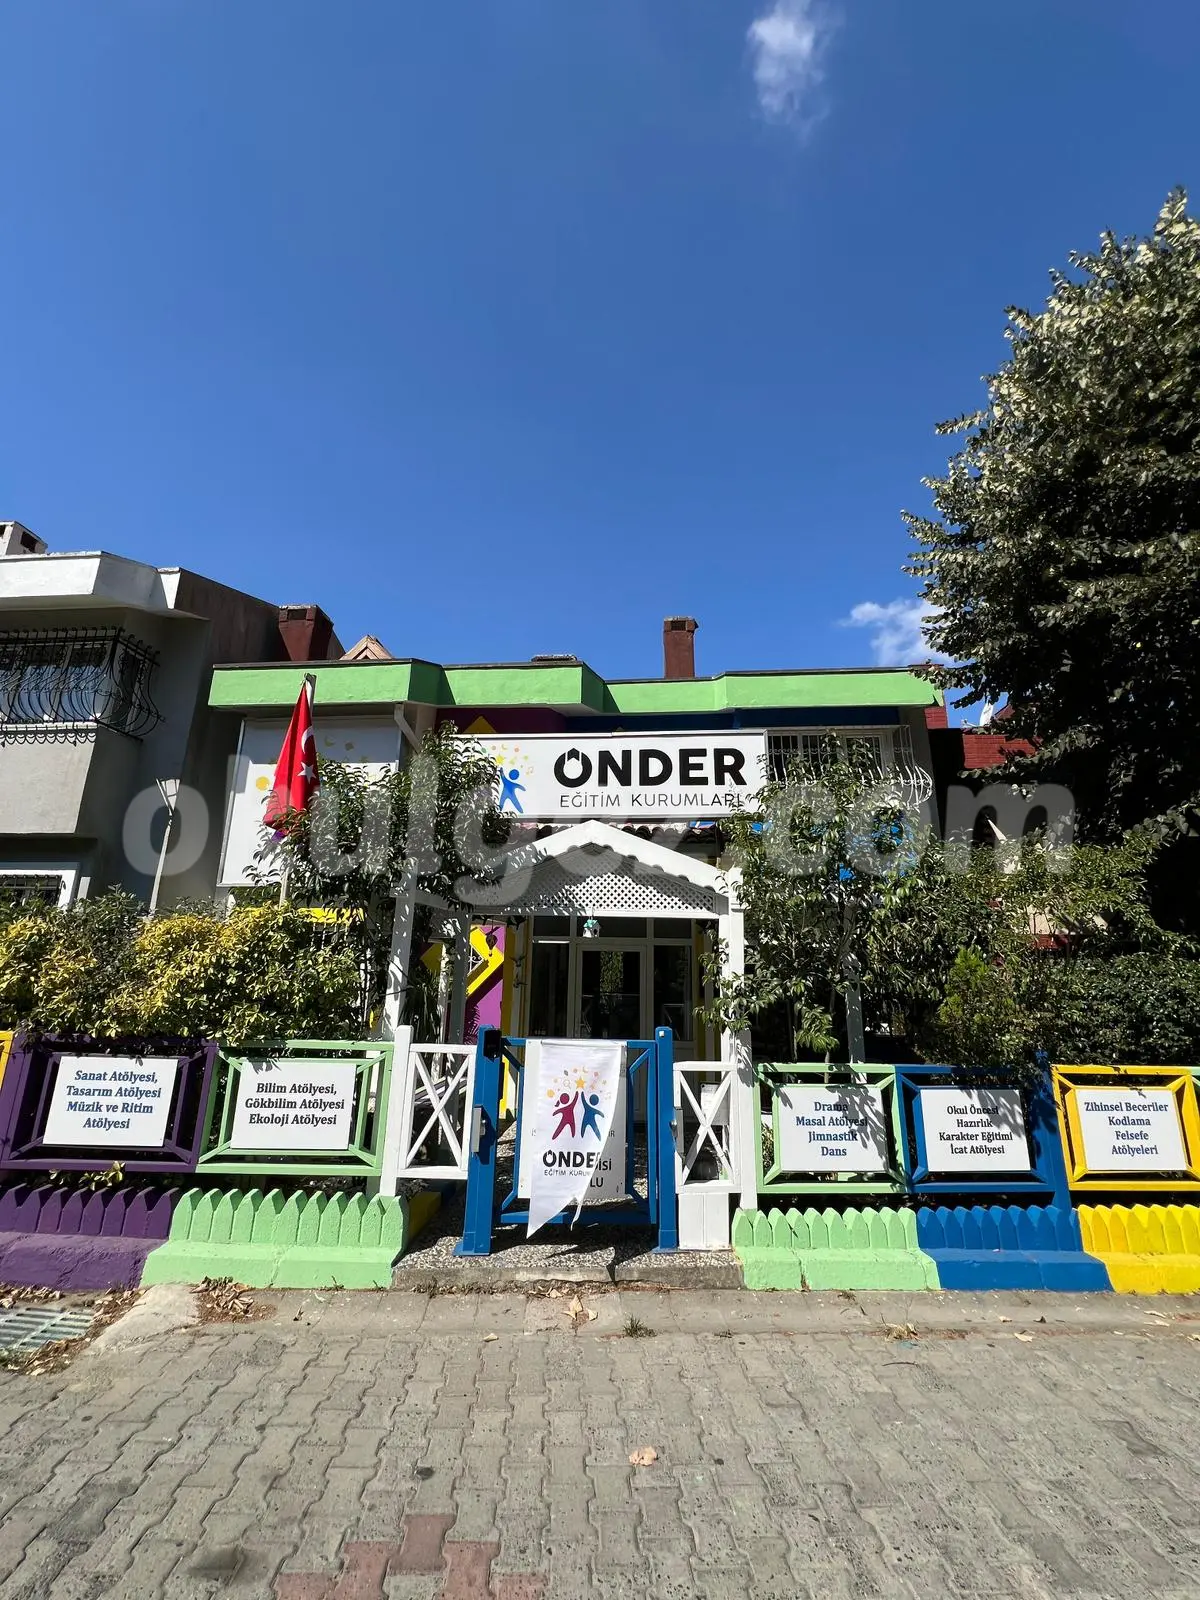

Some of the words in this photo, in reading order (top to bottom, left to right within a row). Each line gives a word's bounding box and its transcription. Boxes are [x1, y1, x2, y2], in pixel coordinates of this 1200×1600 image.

[560, 791, 620, 808] EĞİTİM
[631, 793, 740, 807] KURUMLARI
[75, 1070, 107, 1081] Sanat
[109, 1071, 158, 1084] Atölyesi,
[66, 1085, 112, 1096] Tasarım
[115, 1086, 161, 1100] Atölyesi
[256, 1083, 287, 1093] Bilim
[289, 1083, 337, 1096] Atölyesi,
[66, 1101, 103, 1112] Müzik
[106, 1104, 118, 1112] ve
[121, 1102, 153, 1113] Ritim
[245, 1098, 297, 1109] Gökbilim
[299, 1099, 345, 1111] Atölyesi
[814, 1101, 848, 1111] Drama
[947, 1105, 968, 1114] Okul
[970, 1104, 999, 1114] Öncesi
[1084, 1101, 1123, 1111] Zihinsel
[1125, 1102, 1169, 1111] Beceriler
[83, 1117, 130, 1131] Atölyesi
[249, 1114, 289, 1127] Ekoloji
[291, 1114, 337, 1127] Atölyesi
[796, 1116, 826, 1126] Masal
[828, 1116, 868, 1129] Atölyesi
[956, 1119, 993, 1127] Hazırlık
[1108, 1116, 1151, 1126] Kodlama
[808, 1131, 858, 1143] Jimnastik
[939, 1132, 979, 1140] Karakter
[981, 1131, 1013, 1143] Eğitimi
[1115, 1130, 1149, 1140] Felsefe
[821, 1146, 847, 1156] Dans
[950, 1143, 968, 1154] İcat
[970, 1145, 1005, 1156] Atölyesi
[1111, 1144, 1158, 1157] Atölyeleri
